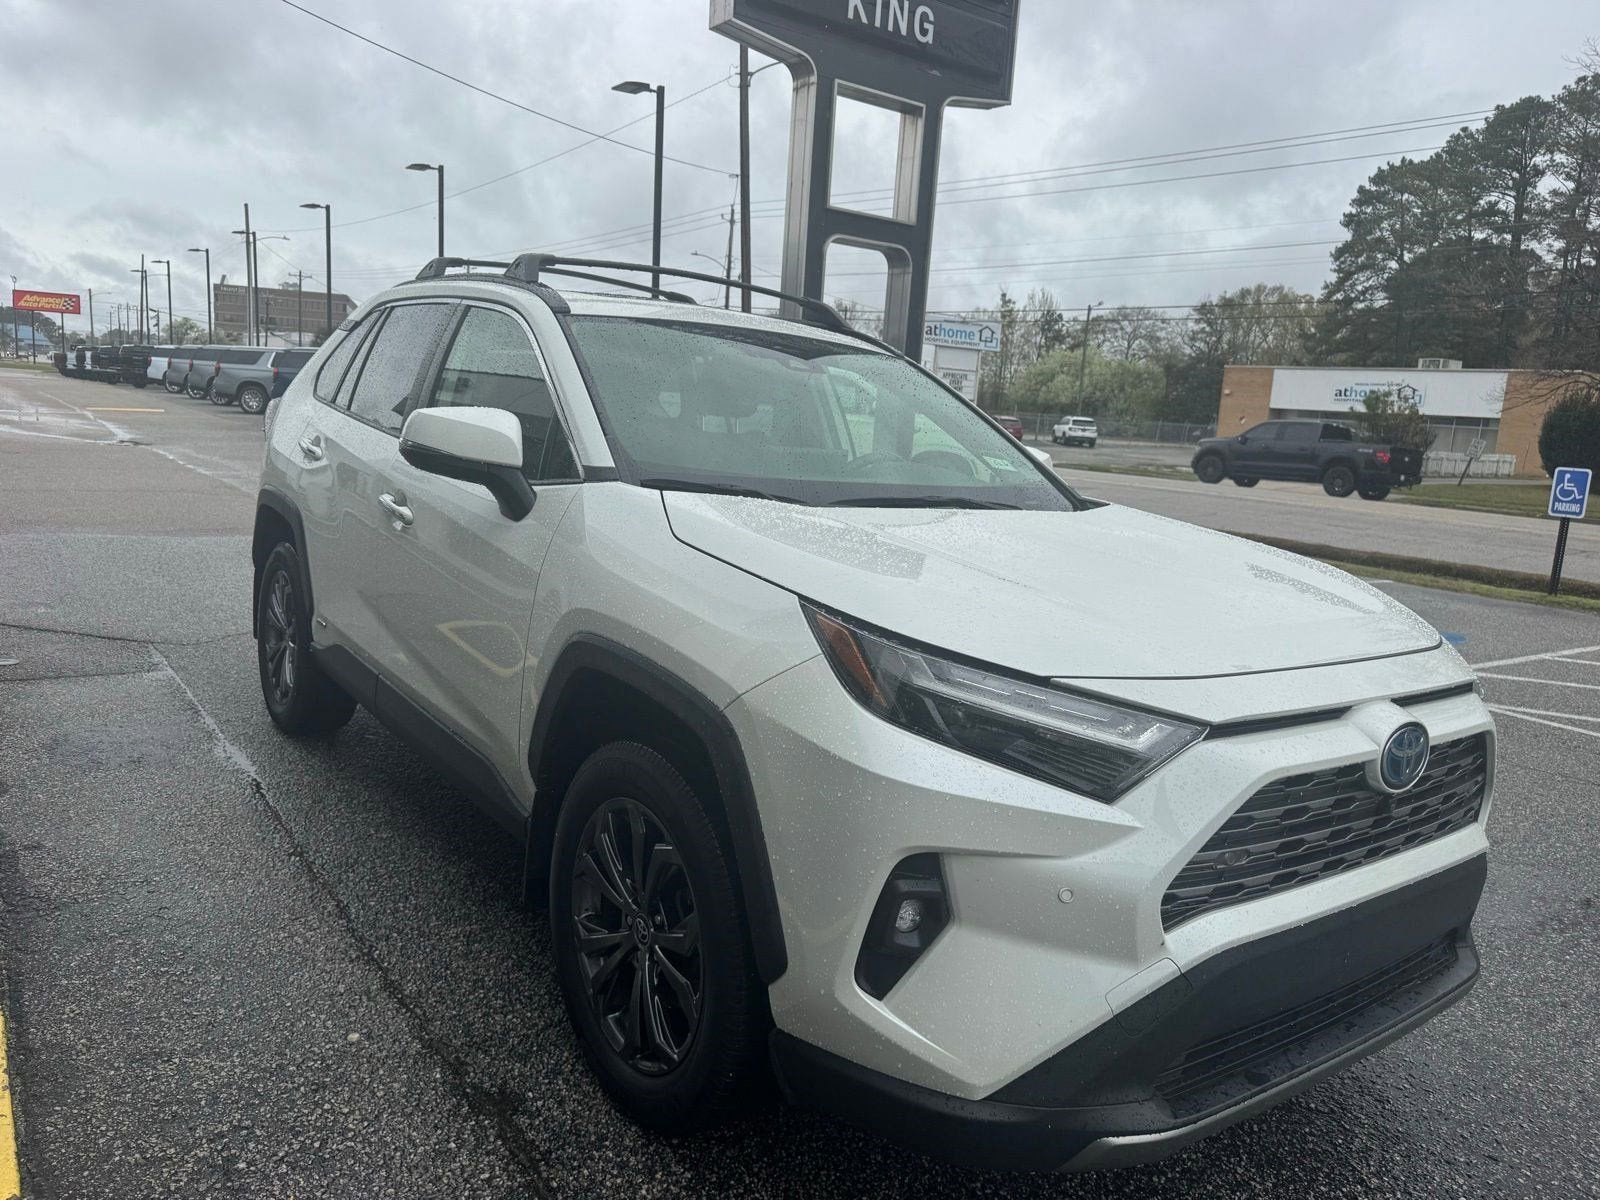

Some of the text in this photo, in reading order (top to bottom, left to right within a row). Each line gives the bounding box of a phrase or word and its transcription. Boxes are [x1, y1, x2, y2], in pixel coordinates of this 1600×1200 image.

[847, 0, 935, 45] KING
[22, 294, 62, 303] Advance
[925, 323, 976, 341] athome
[924, 336, 981, 347] HOSPITAL EQUIPMENT
[1334, 386, 1380, 398] atho
[1553, 501, 1581, 513] PARKING
